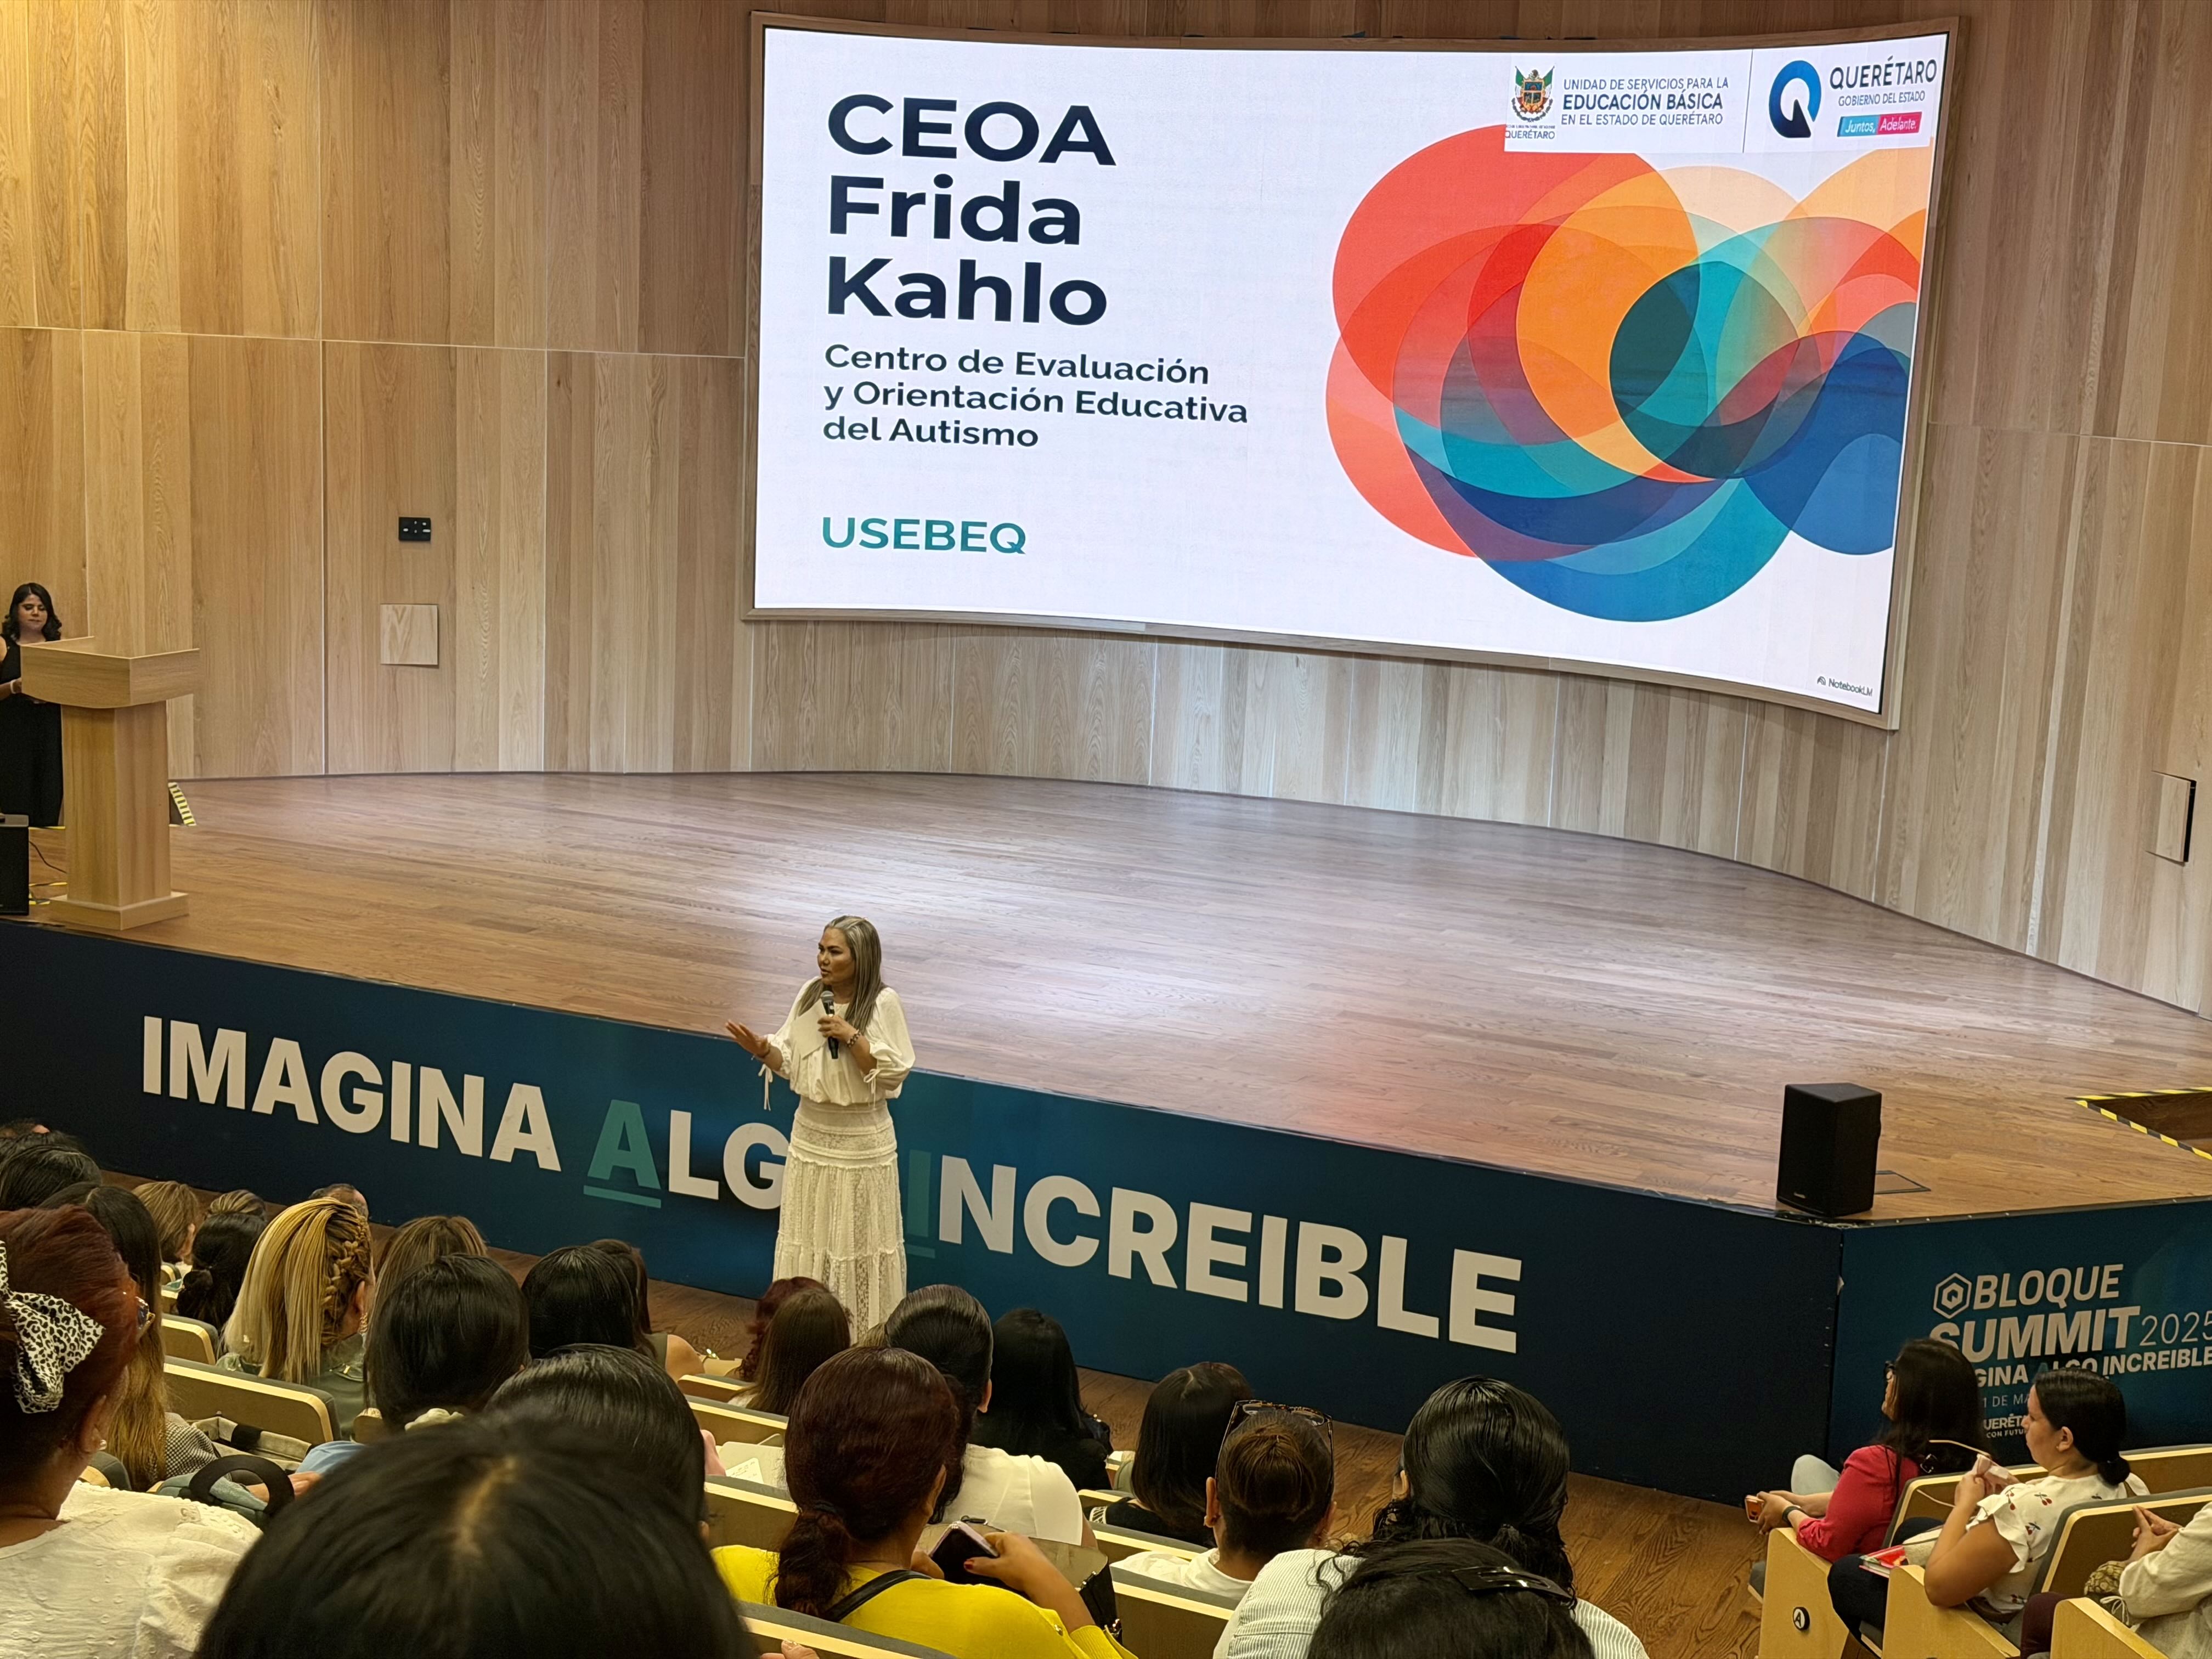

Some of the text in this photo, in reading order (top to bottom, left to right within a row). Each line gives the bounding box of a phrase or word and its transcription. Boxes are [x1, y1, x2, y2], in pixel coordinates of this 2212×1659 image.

[1564, 77, 1729, 90] UNIDAD DE SERVICIOS PARA LA
[1830, 55, 1937, 90] QUERÉTARO
[1563, 89, 1723, 110] EDUCACIÓN BÁSICA
[1838, 90, 1925, 106] GOBIERNO DEL ESTADO
[828, 94, 1116, 166] CEOA
[1561, 111, 1723, 126] EN EL ESTADO DE QUERÉTARO
[1845, 116, 1917, 134] Juntos, Adelante.
[830, 173, 1080, 245] Frida
[828, 256, 1107, 326] Kahlo
[825, 344, 1209, 385] Centro de Evaluación
[823, 381, 1248, 424] y Orientación Educativa
[823, 416, 1039, 447] del Autismo
[823, 517, 1026, 554] USEBEQ
[1829, 678, 1873, 696] NotebookLM
[144, 1015, 1522, 1354] IMAGINA ALG INCREIBLE
[1973, 1264, 2124, 1308] BLOQUE
[2140, 1310, 2212, 1346] 2025
[1975, 1364, 2028, 1387] GINA
[2103, 1346, 2212, 1375] INCREIBLE
[1993, 1395, 2008, 1407] DE
[1983, 1413, 2023, 1430] UERÉT
[1793, 1611, 1802, 1627] A
